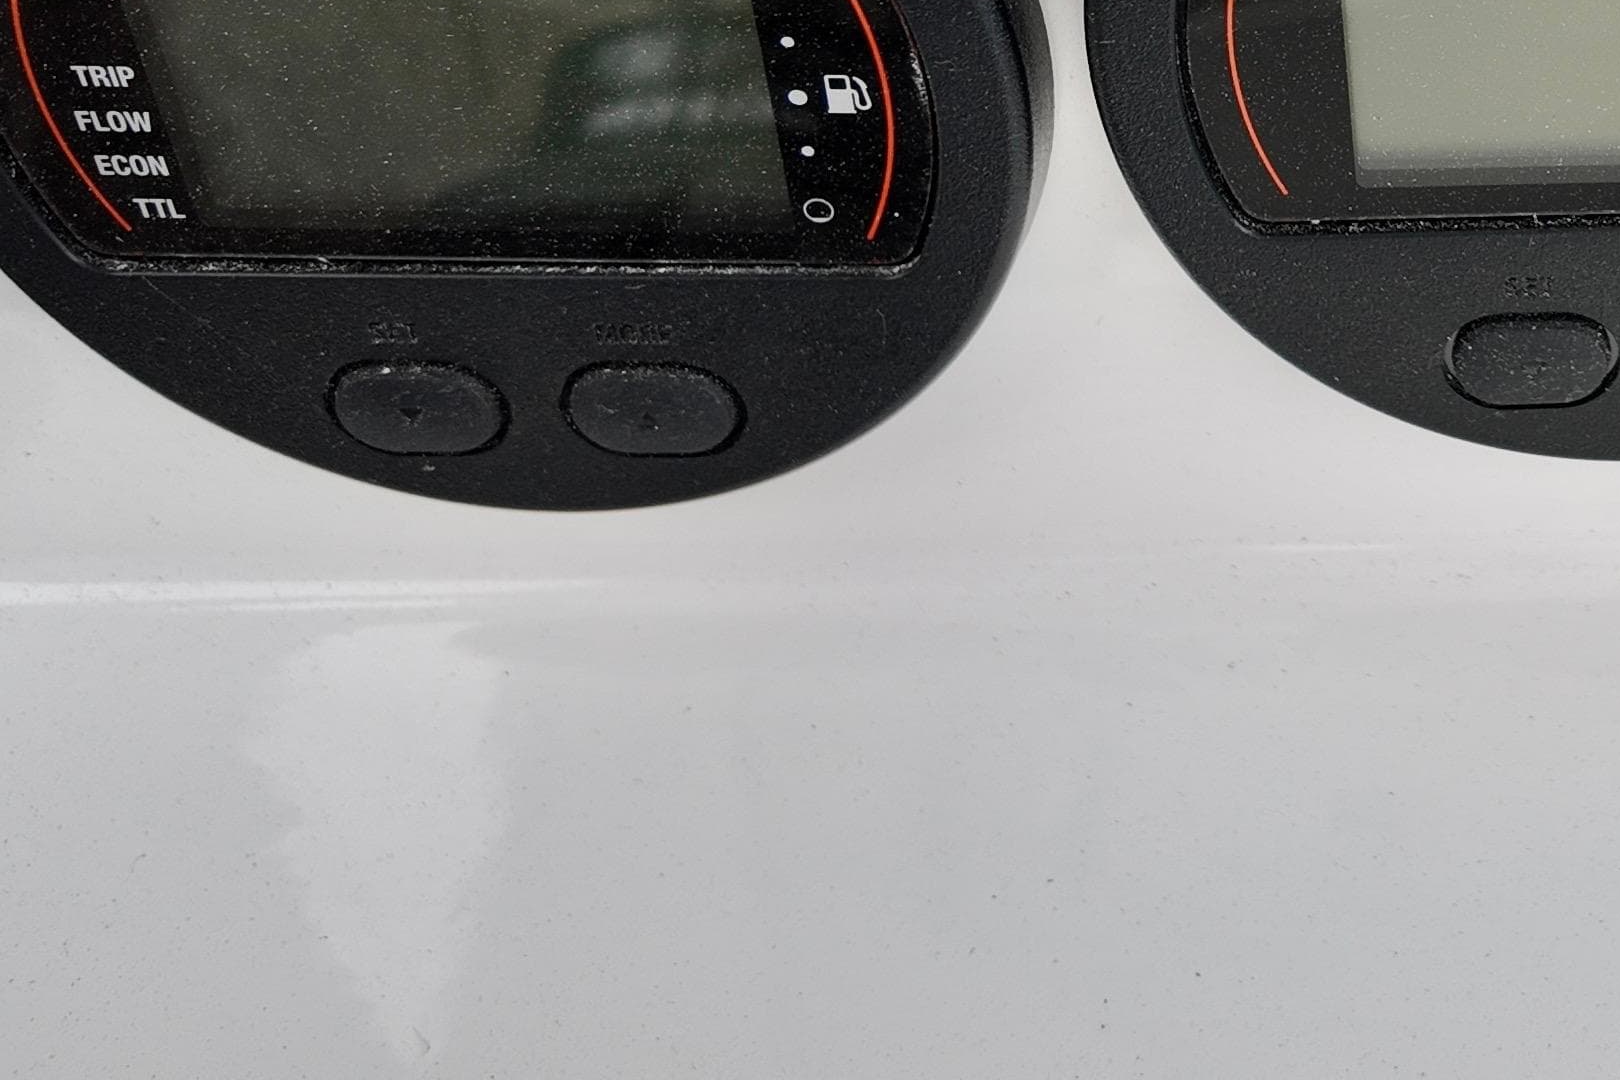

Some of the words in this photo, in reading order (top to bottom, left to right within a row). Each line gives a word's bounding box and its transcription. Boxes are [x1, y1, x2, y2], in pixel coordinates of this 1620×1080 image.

[70, 64, 135, 88] TRIP
[74, 110, 152, 133] FLOW
[94, 154, 170, 177] ECON
[132, 198, 187, 220] TTL
